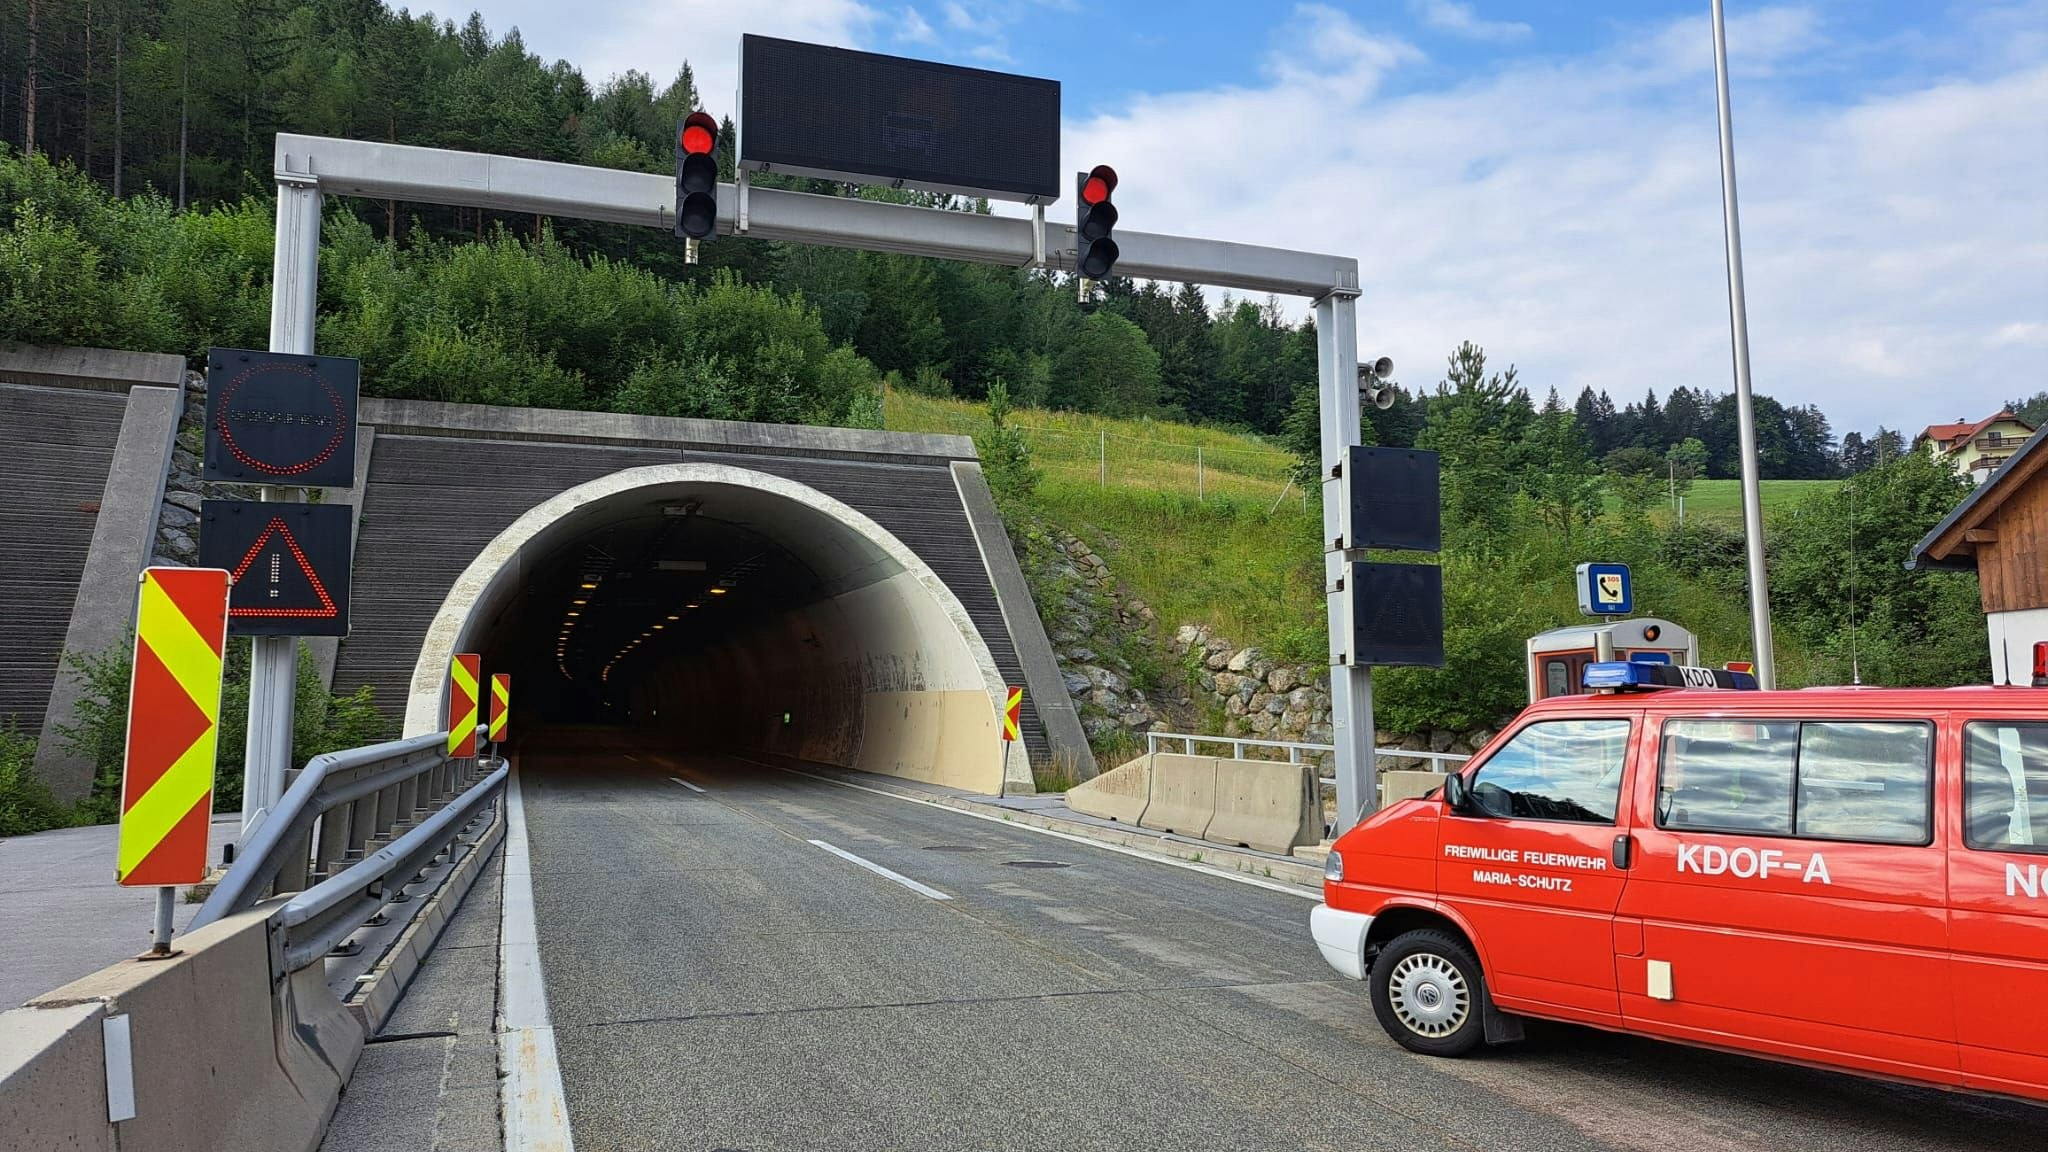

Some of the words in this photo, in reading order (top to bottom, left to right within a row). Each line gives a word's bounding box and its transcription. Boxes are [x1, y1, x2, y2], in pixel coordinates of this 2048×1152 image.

[1681, 668, 1714, 687] KDO
[1444, 844, 1519, 862] FREIWILLIGE
[1523, 851, 1607, 870] FEUERWEHR
[1677, 843, 1832, 885] KDOF-A
[1473, 870, 1572, 892] MARIA-SCHUTZ
[2006, 862, 2048, 898] N
